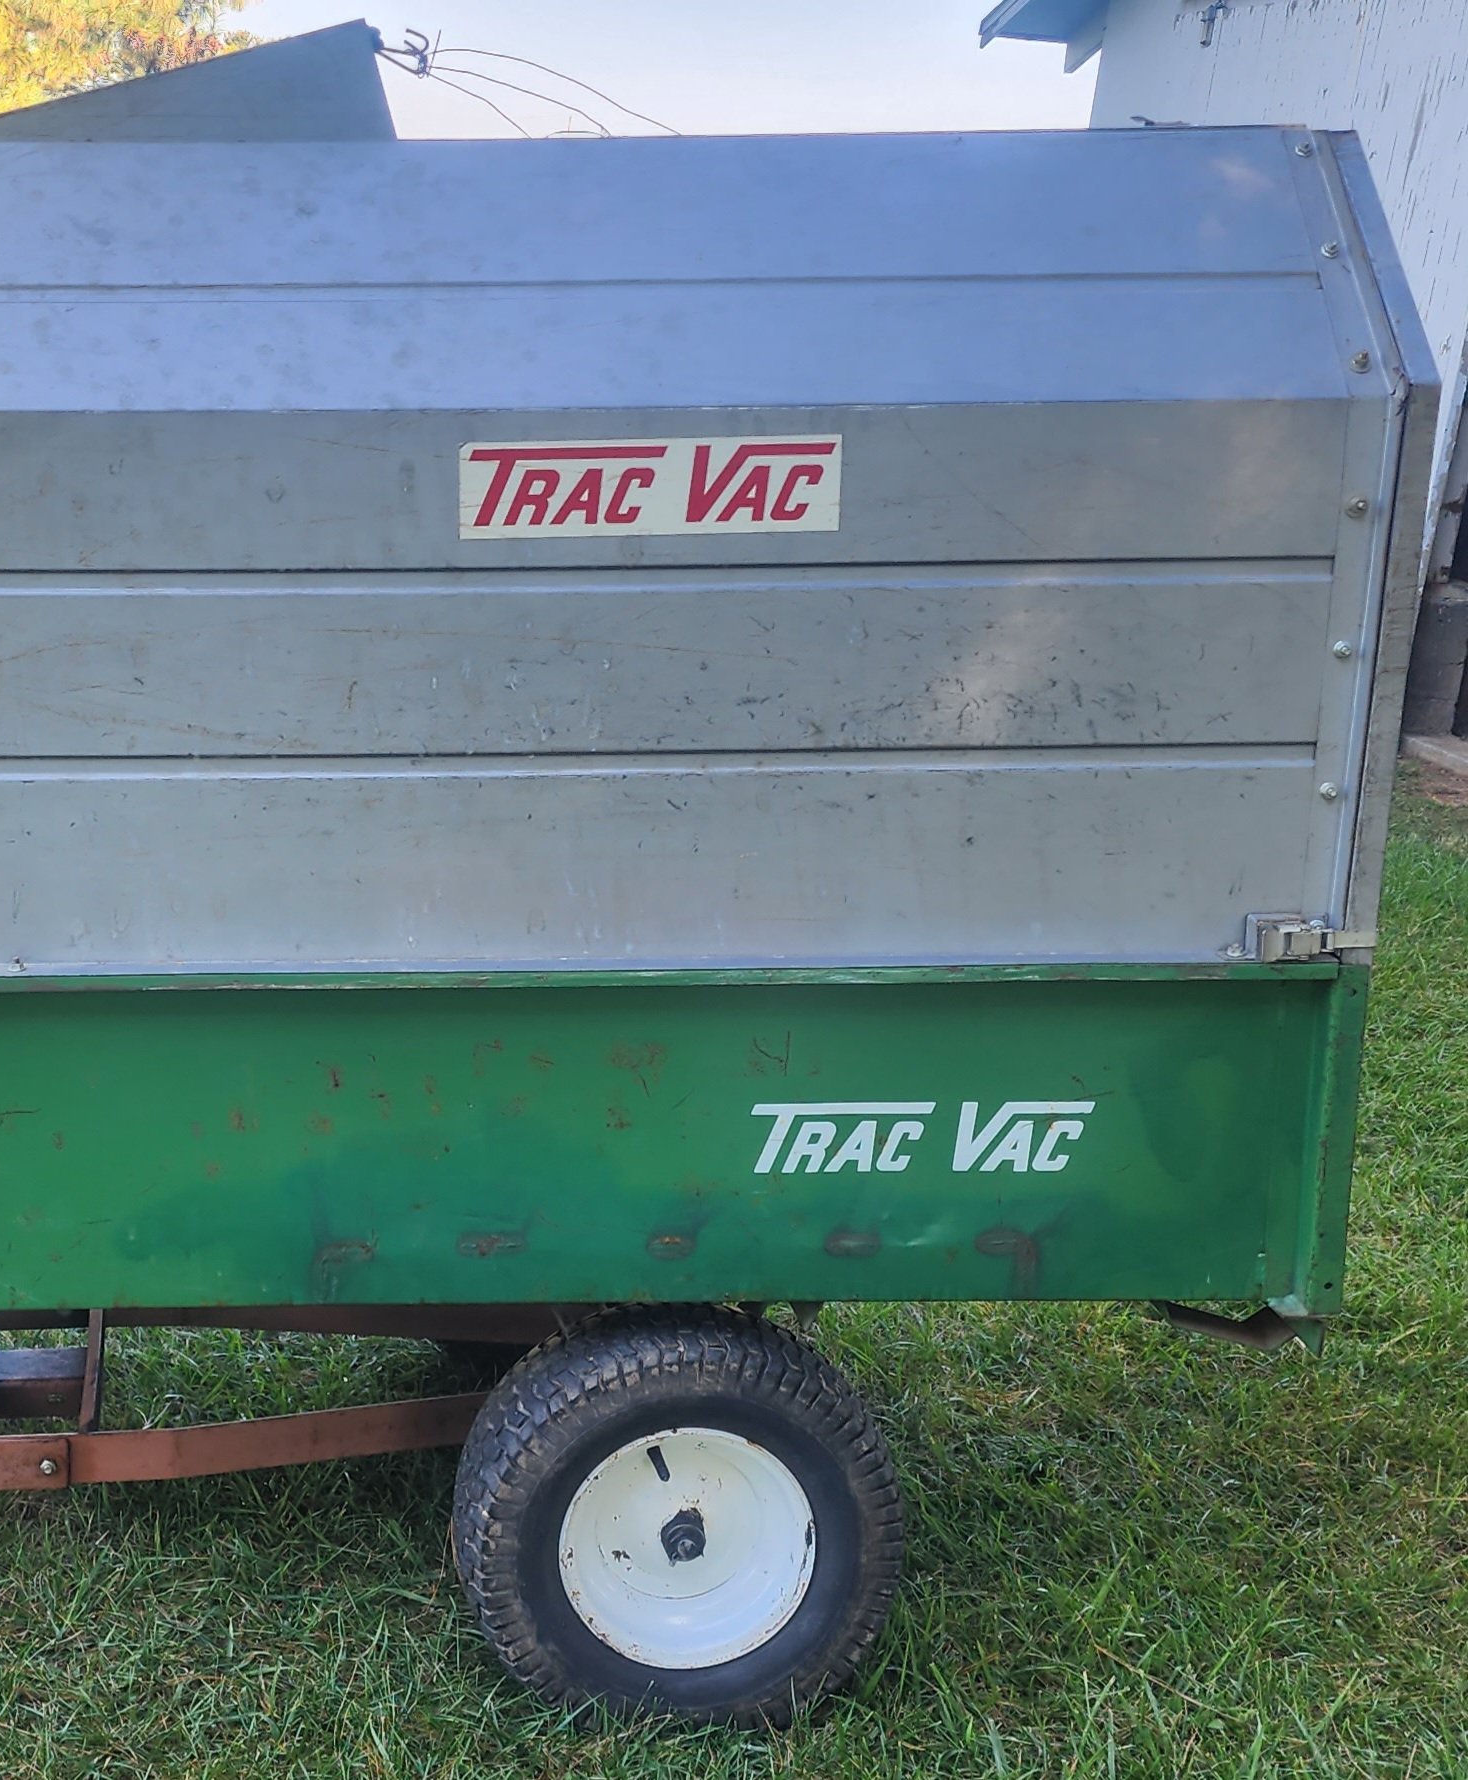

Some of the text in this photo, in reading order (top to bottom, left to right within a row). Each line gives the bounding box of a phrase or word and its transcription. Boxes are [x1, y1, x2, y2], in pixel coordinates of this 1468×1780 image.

[469, 442, 836, 526] TRAC VAC
[750, 1101, 1096, 1174] TRAC VAC
